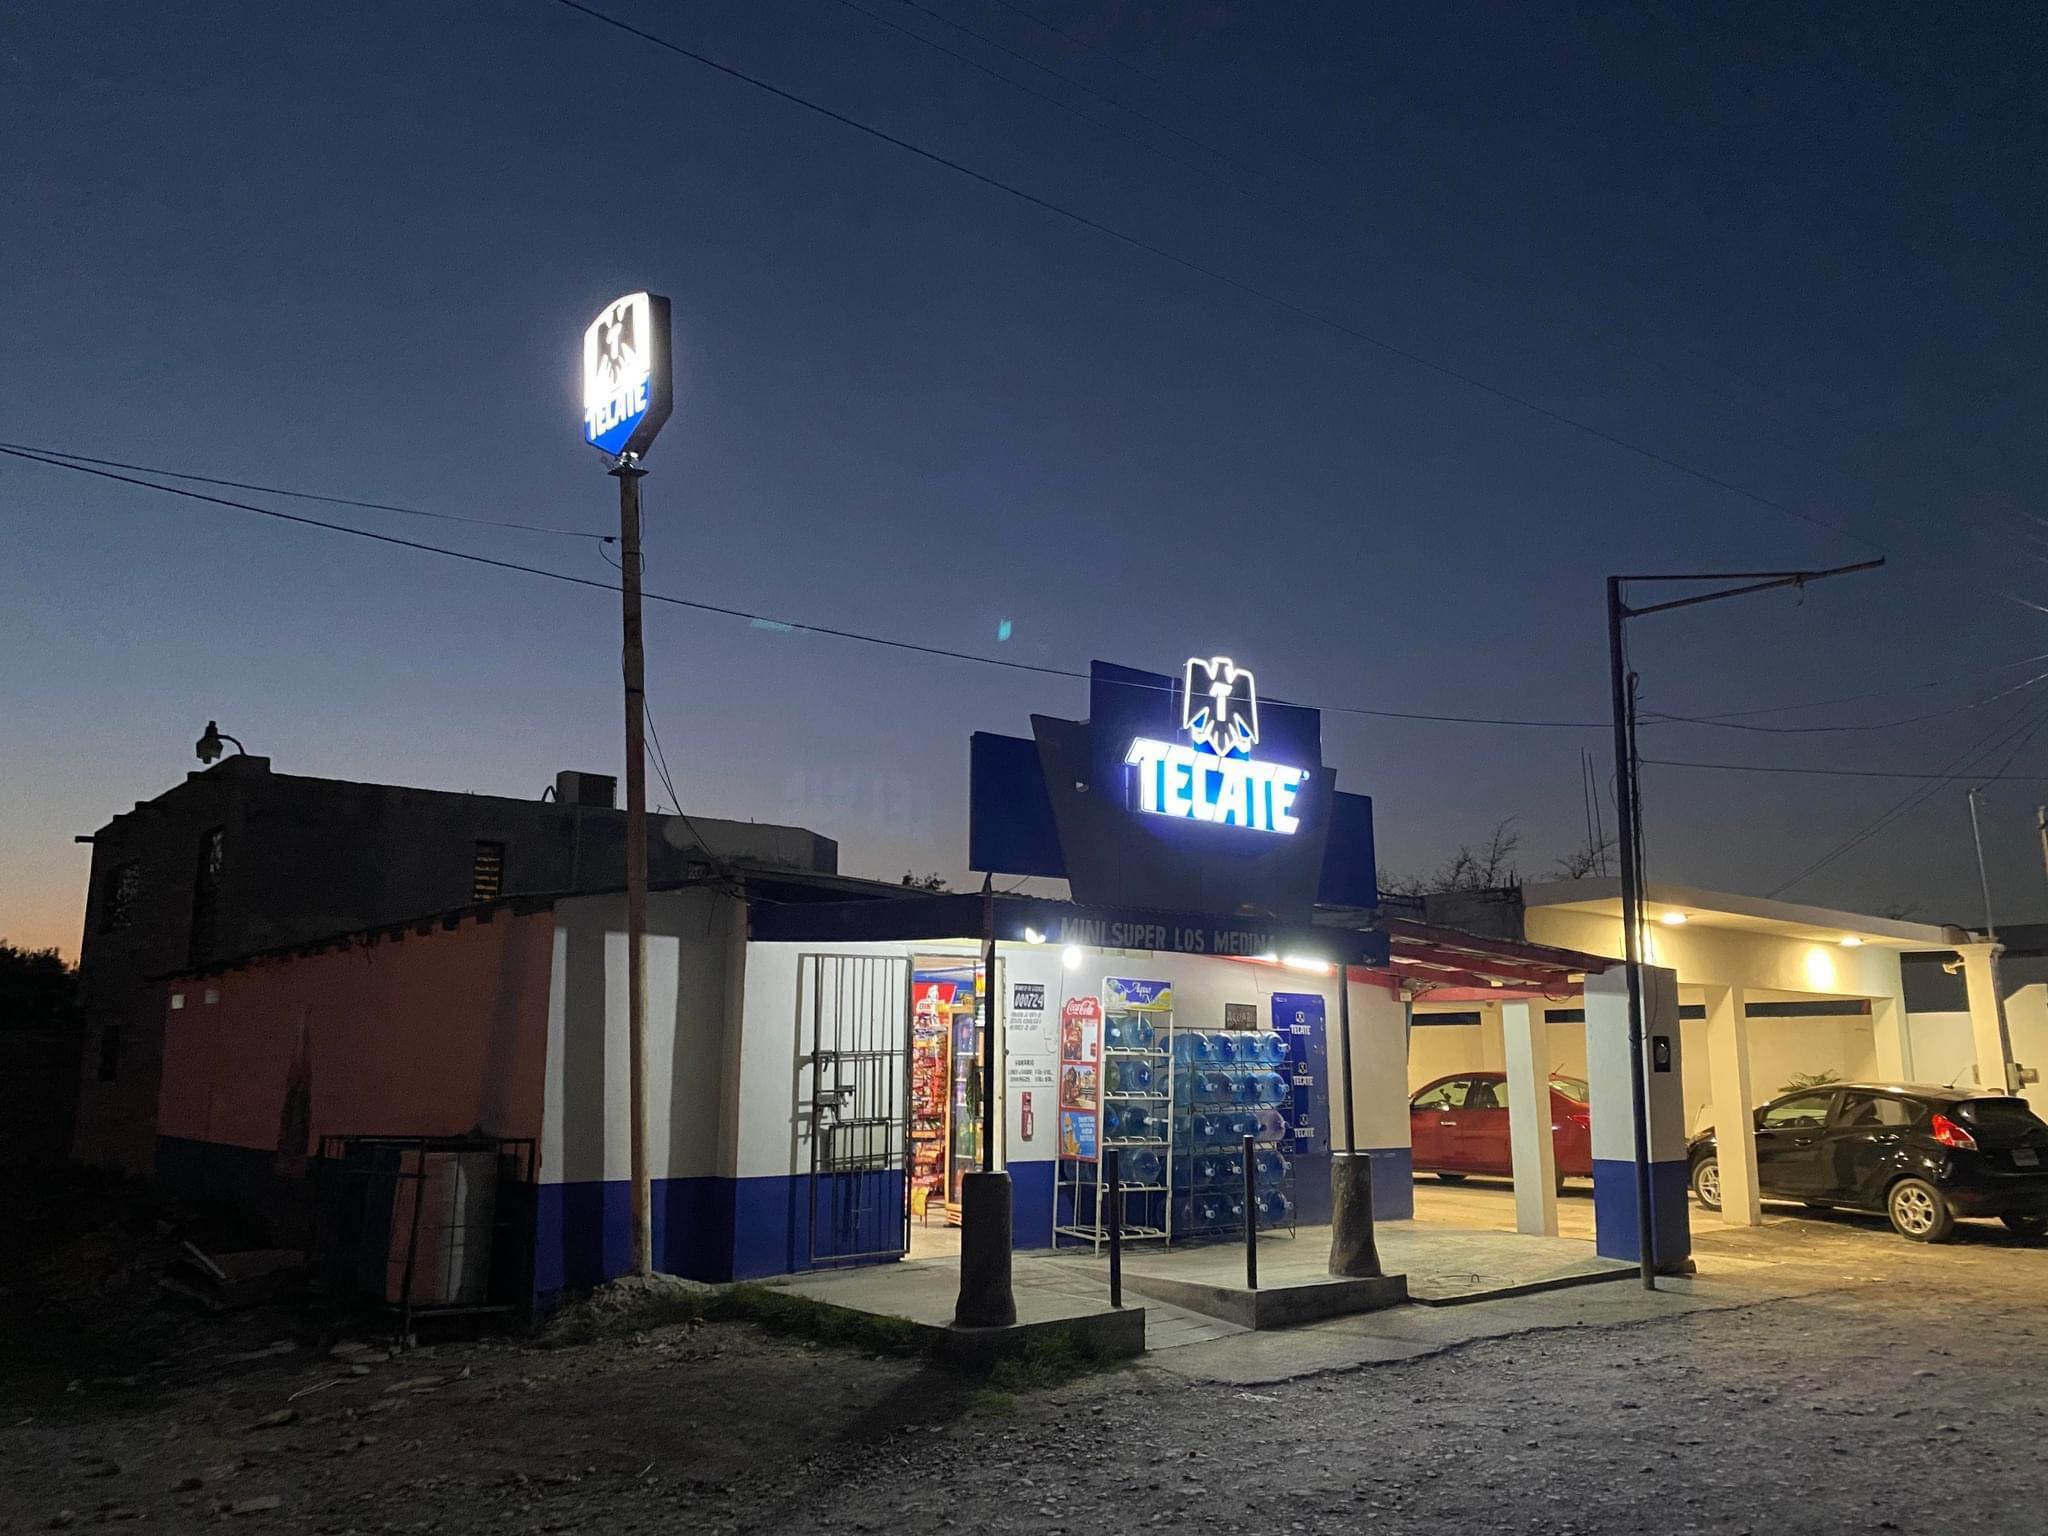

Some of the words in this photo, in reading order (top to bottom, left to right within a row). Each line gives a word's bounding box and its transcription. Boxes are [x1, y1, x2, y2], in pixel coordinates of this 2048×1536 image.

[581, 373, 649, 441] TECATE
[1124, 736, 1303, 835] TECATE
[1060, 917, 1106, 946] MINI
[1111, 922, 1165, 949] SUPER
[1174, 927, 1205, 951] LOS
[1290, 1024, 1311, 1035] TECATE
[1293, 1075, 1314, 1086] TECATE
[1294, 1127, 1315, 1138] TECATE
